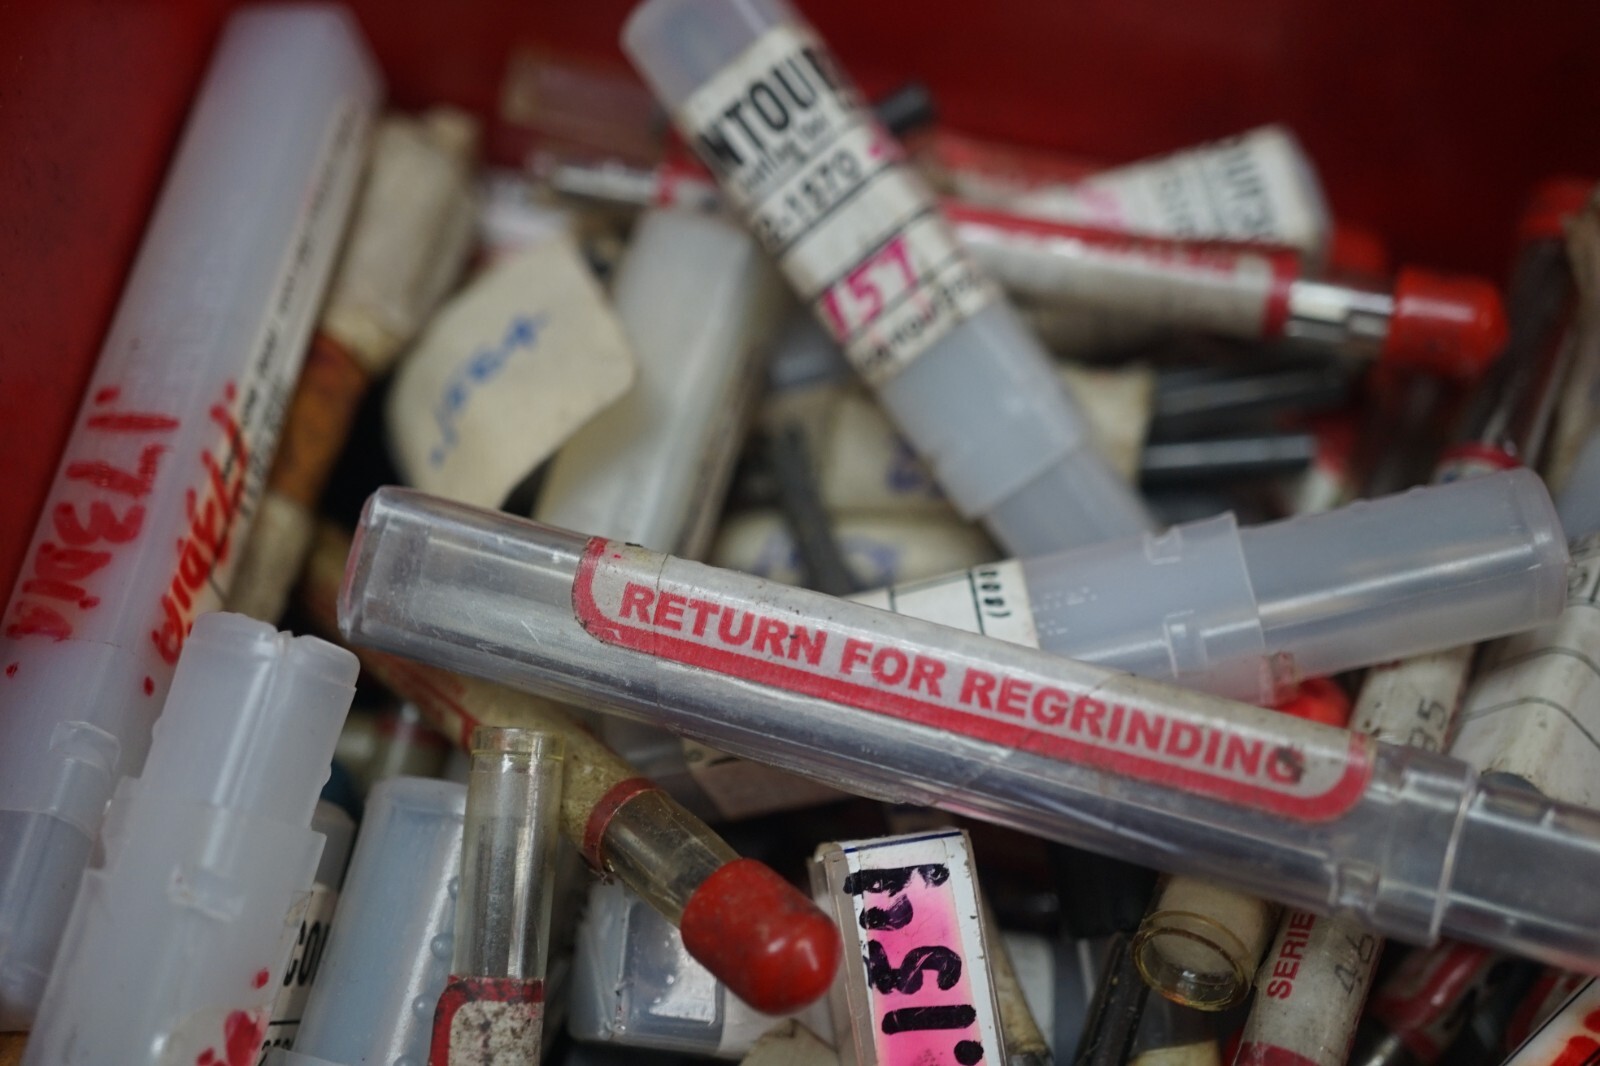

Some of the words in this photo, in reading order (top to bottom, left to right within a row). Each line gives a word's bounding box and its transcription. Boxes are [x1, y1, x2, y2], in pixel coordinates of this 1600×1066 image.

[620, 580, 828, 667] RETURN
[840, 639, 946, 699] FOR
[958, 666, 1306, 788] REGRINDING
